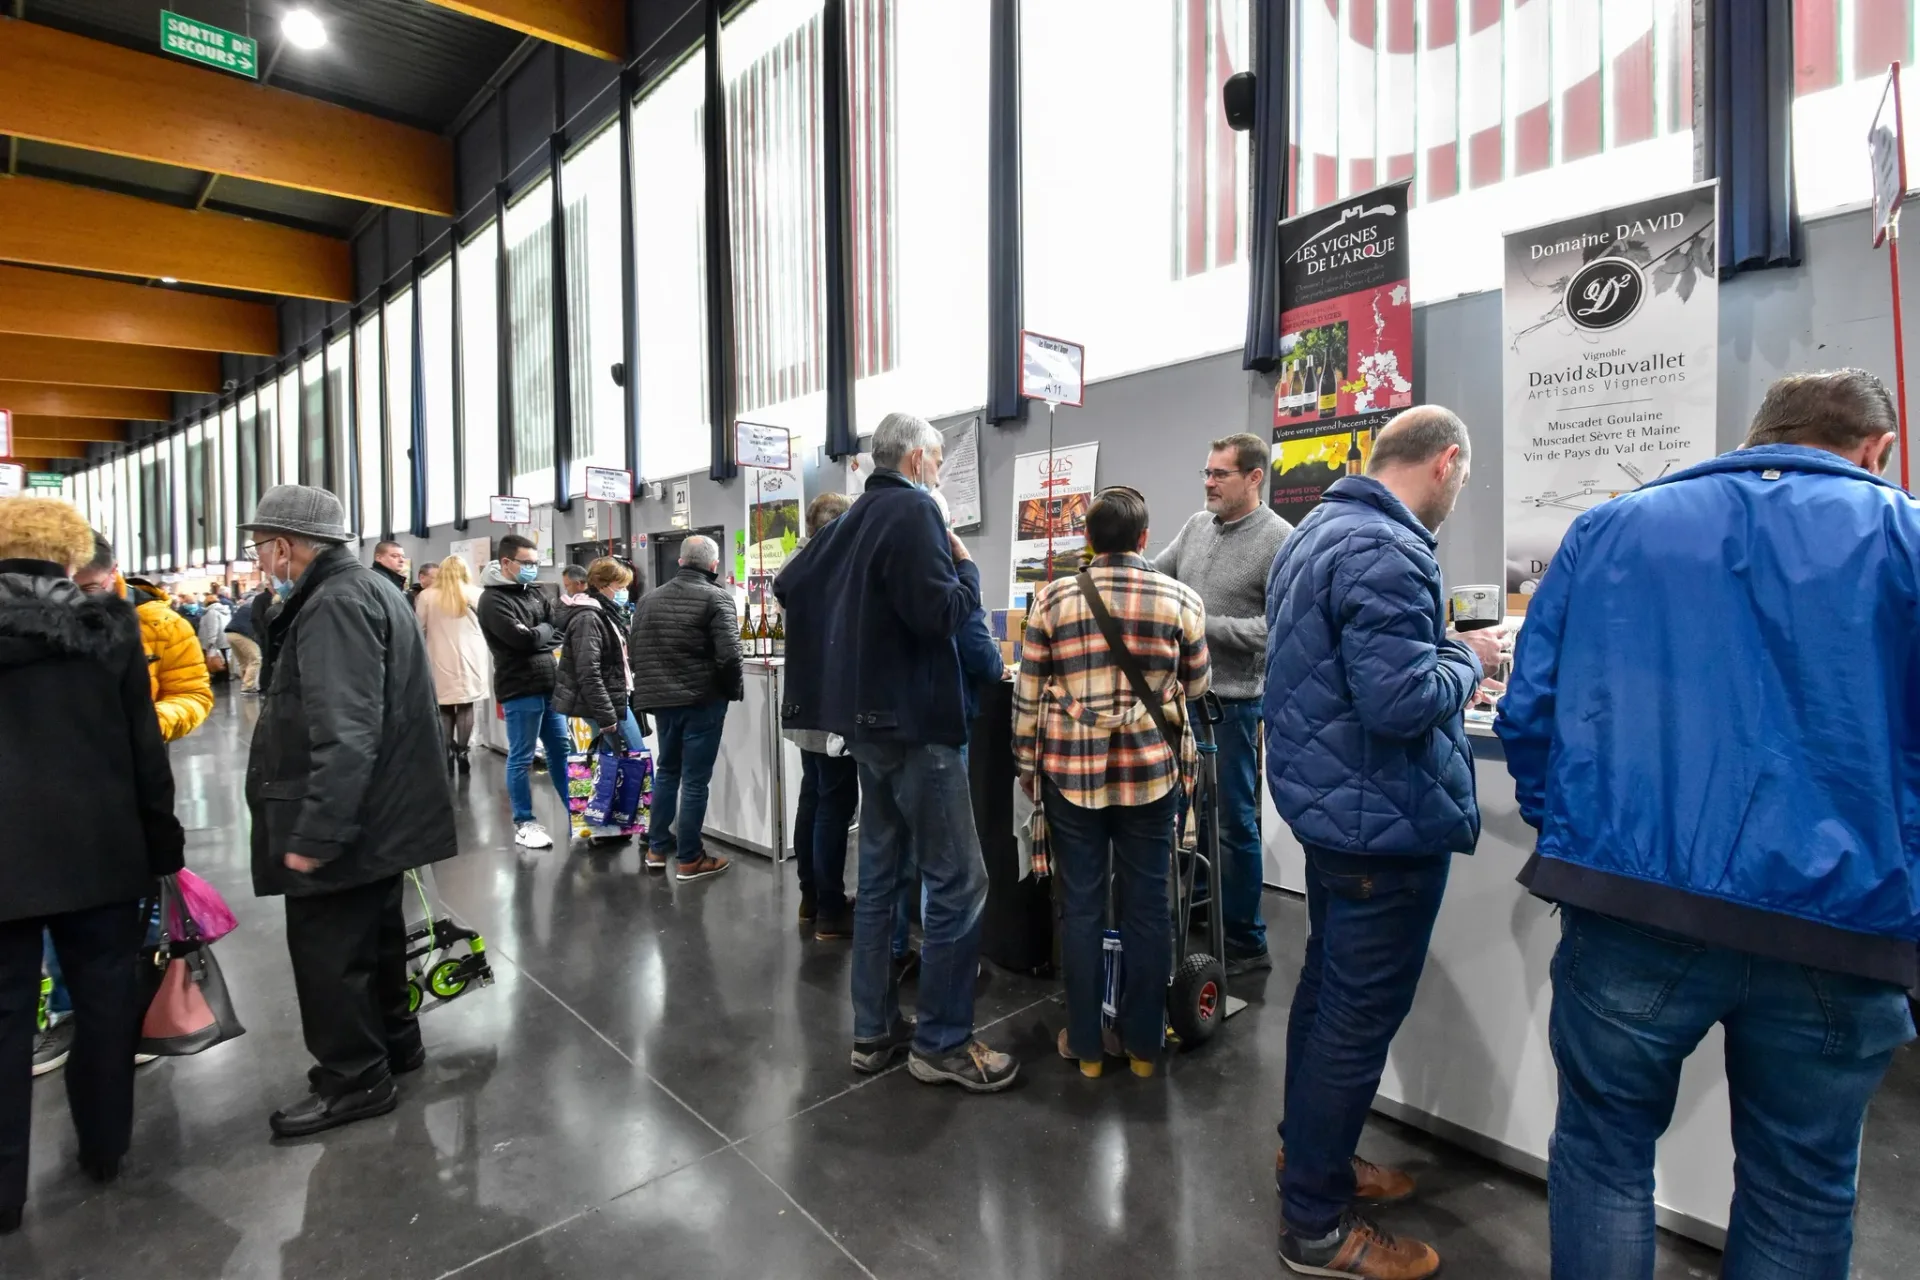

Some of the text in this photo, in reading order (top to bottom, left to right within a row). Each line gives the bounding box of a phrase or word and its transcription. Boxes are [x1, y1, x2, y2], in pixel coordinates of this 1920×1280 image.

[168, 18, 252, 56] SORTIE DE
[168, 34, 237, 66] SECOURS
[1296, 225, 1377, 264] LES VIGNES
[1530, 211, 1684, 260] Domaine DAVID
[1307, 236, 1395, 275] DE L'ARQUE
[1583, 348, 1626, 362] Vignoble
[1528, 370, 1686, 401] Artisans Vignerons
[1276, 429, 1295, 439] Votre
[1315, 421, 1337, 435] prend
[1338, 419, 1367, 429] l'accent
[1368, 415, 1379, 425] du
[1548, 410, 1663, 432] Muscadet Goulaine
[1532, 433, 1586, 448] Muscadet
[1590, 430, 1623, 441] Sèvre
[1641, 425, 1681, 437] Maine
[755, 454, 772, 463] A 12
[1523, 438, 1691, 462] Vin de Pays du Val de Loire
[677, 491, 686, 504] 21
